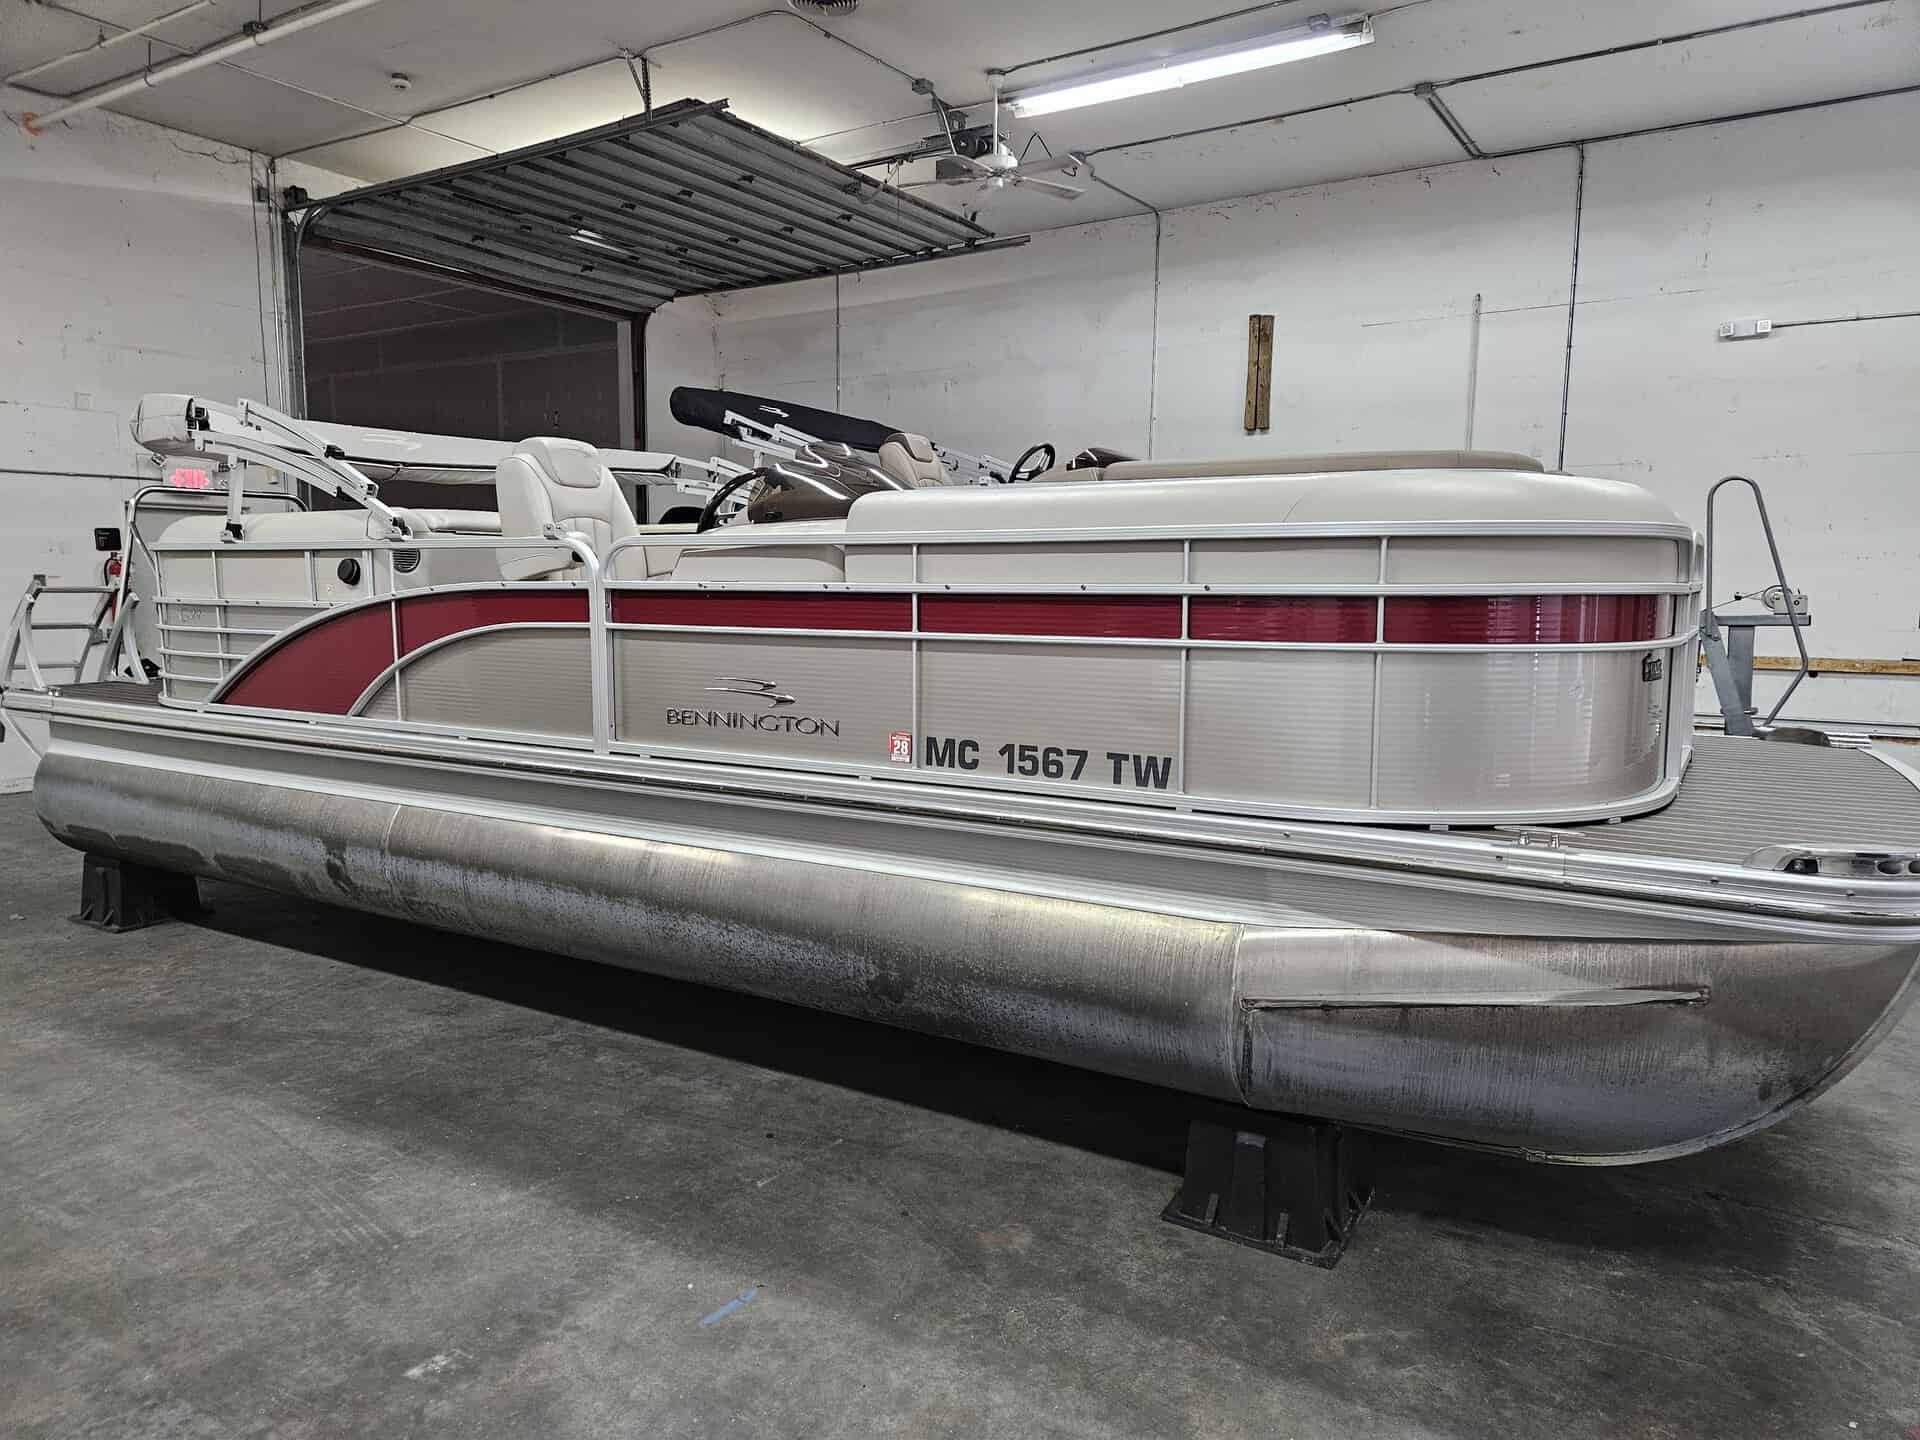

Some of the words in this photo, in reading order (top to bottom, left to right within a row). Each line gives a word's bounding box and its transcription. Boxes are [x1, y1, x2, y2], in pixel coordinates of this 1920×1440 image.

[666, 708, 840, 737] BENNINGTON
[893, 739, 909, 755] 28
[925, 735, 980, 770] MC
[998, 742, 1089, 781] 1567
[1106, 751, 1172, 790] TW
